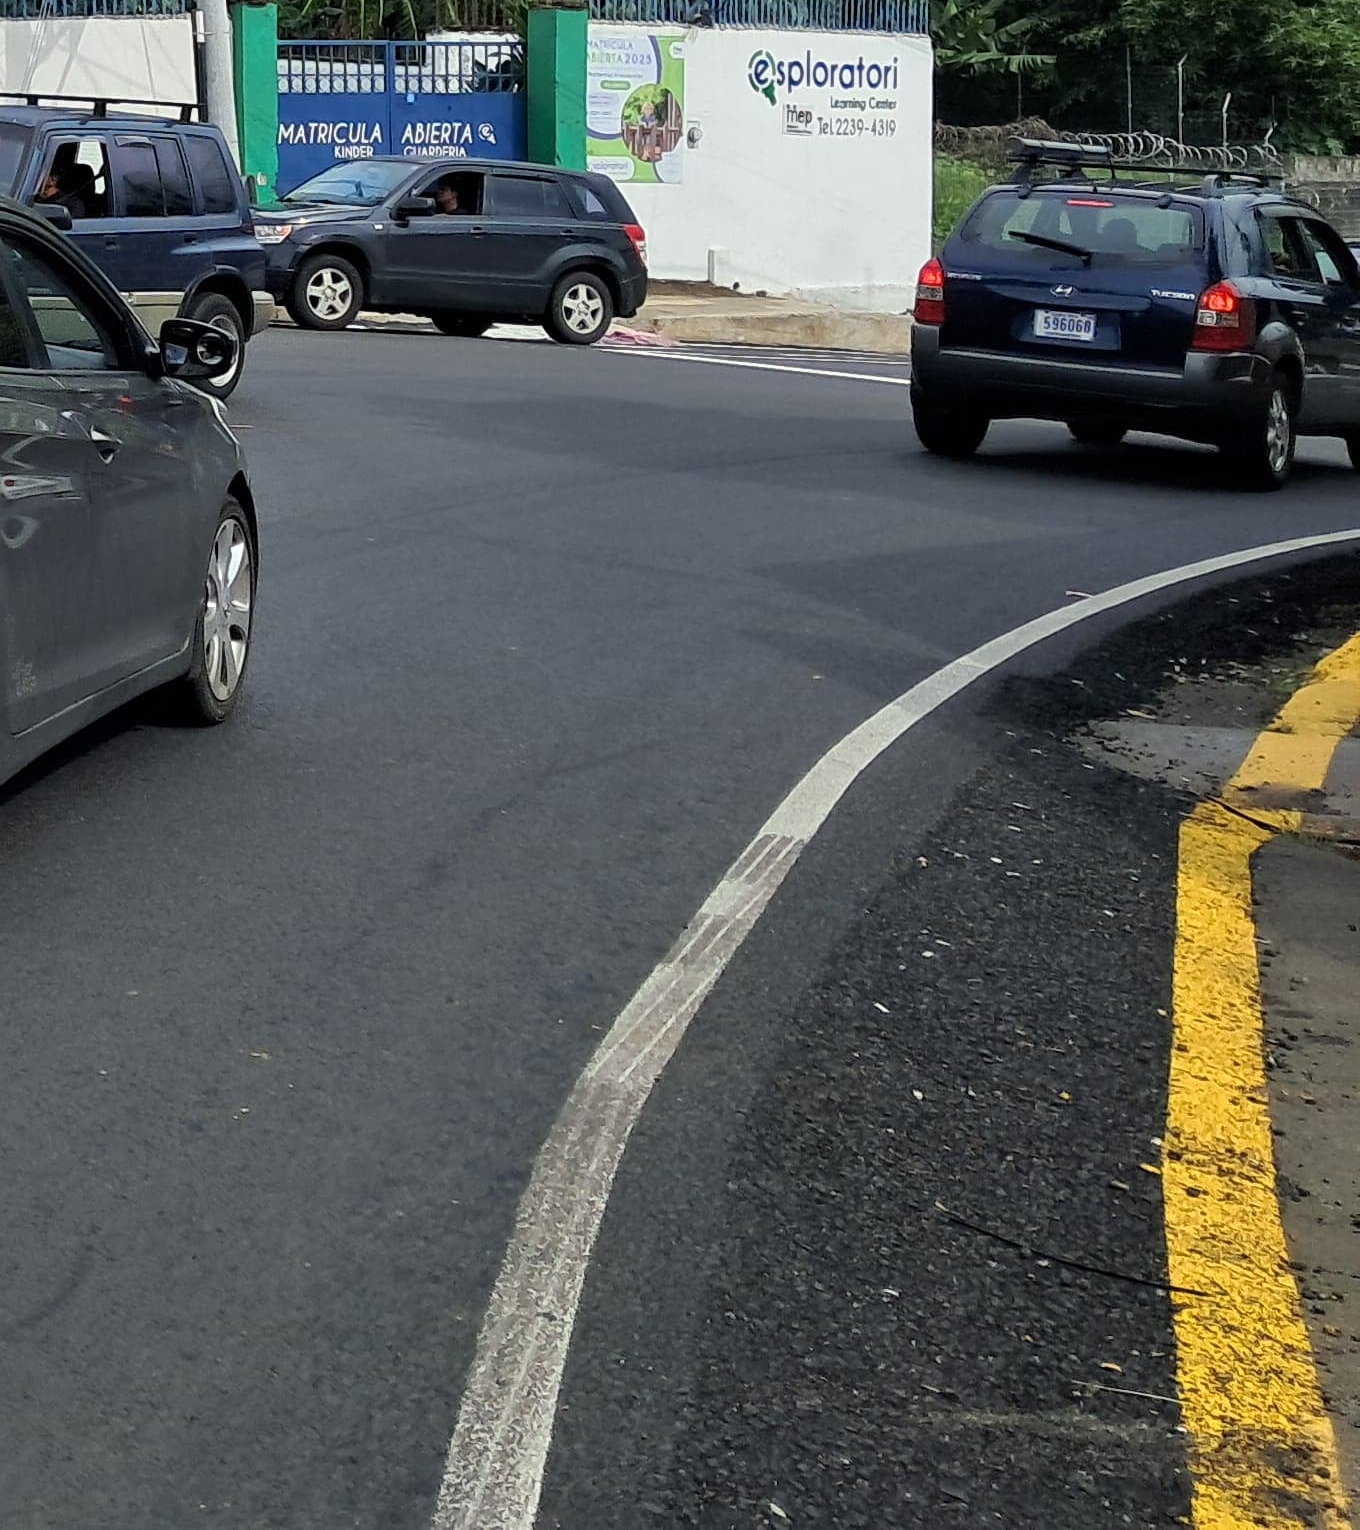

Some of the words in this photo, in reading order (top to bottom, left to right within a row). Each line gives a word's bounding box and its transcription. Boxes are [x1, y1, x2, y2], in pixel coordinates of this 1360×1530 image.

[751, 50, 898, 94] esploratori
[830, 96, 867, 111] Learning
[277, 123, 383, 145] MATRICULA
[401, 123, 473, 145] ABIERTA
[334, 146, 374, 159] KINDER
